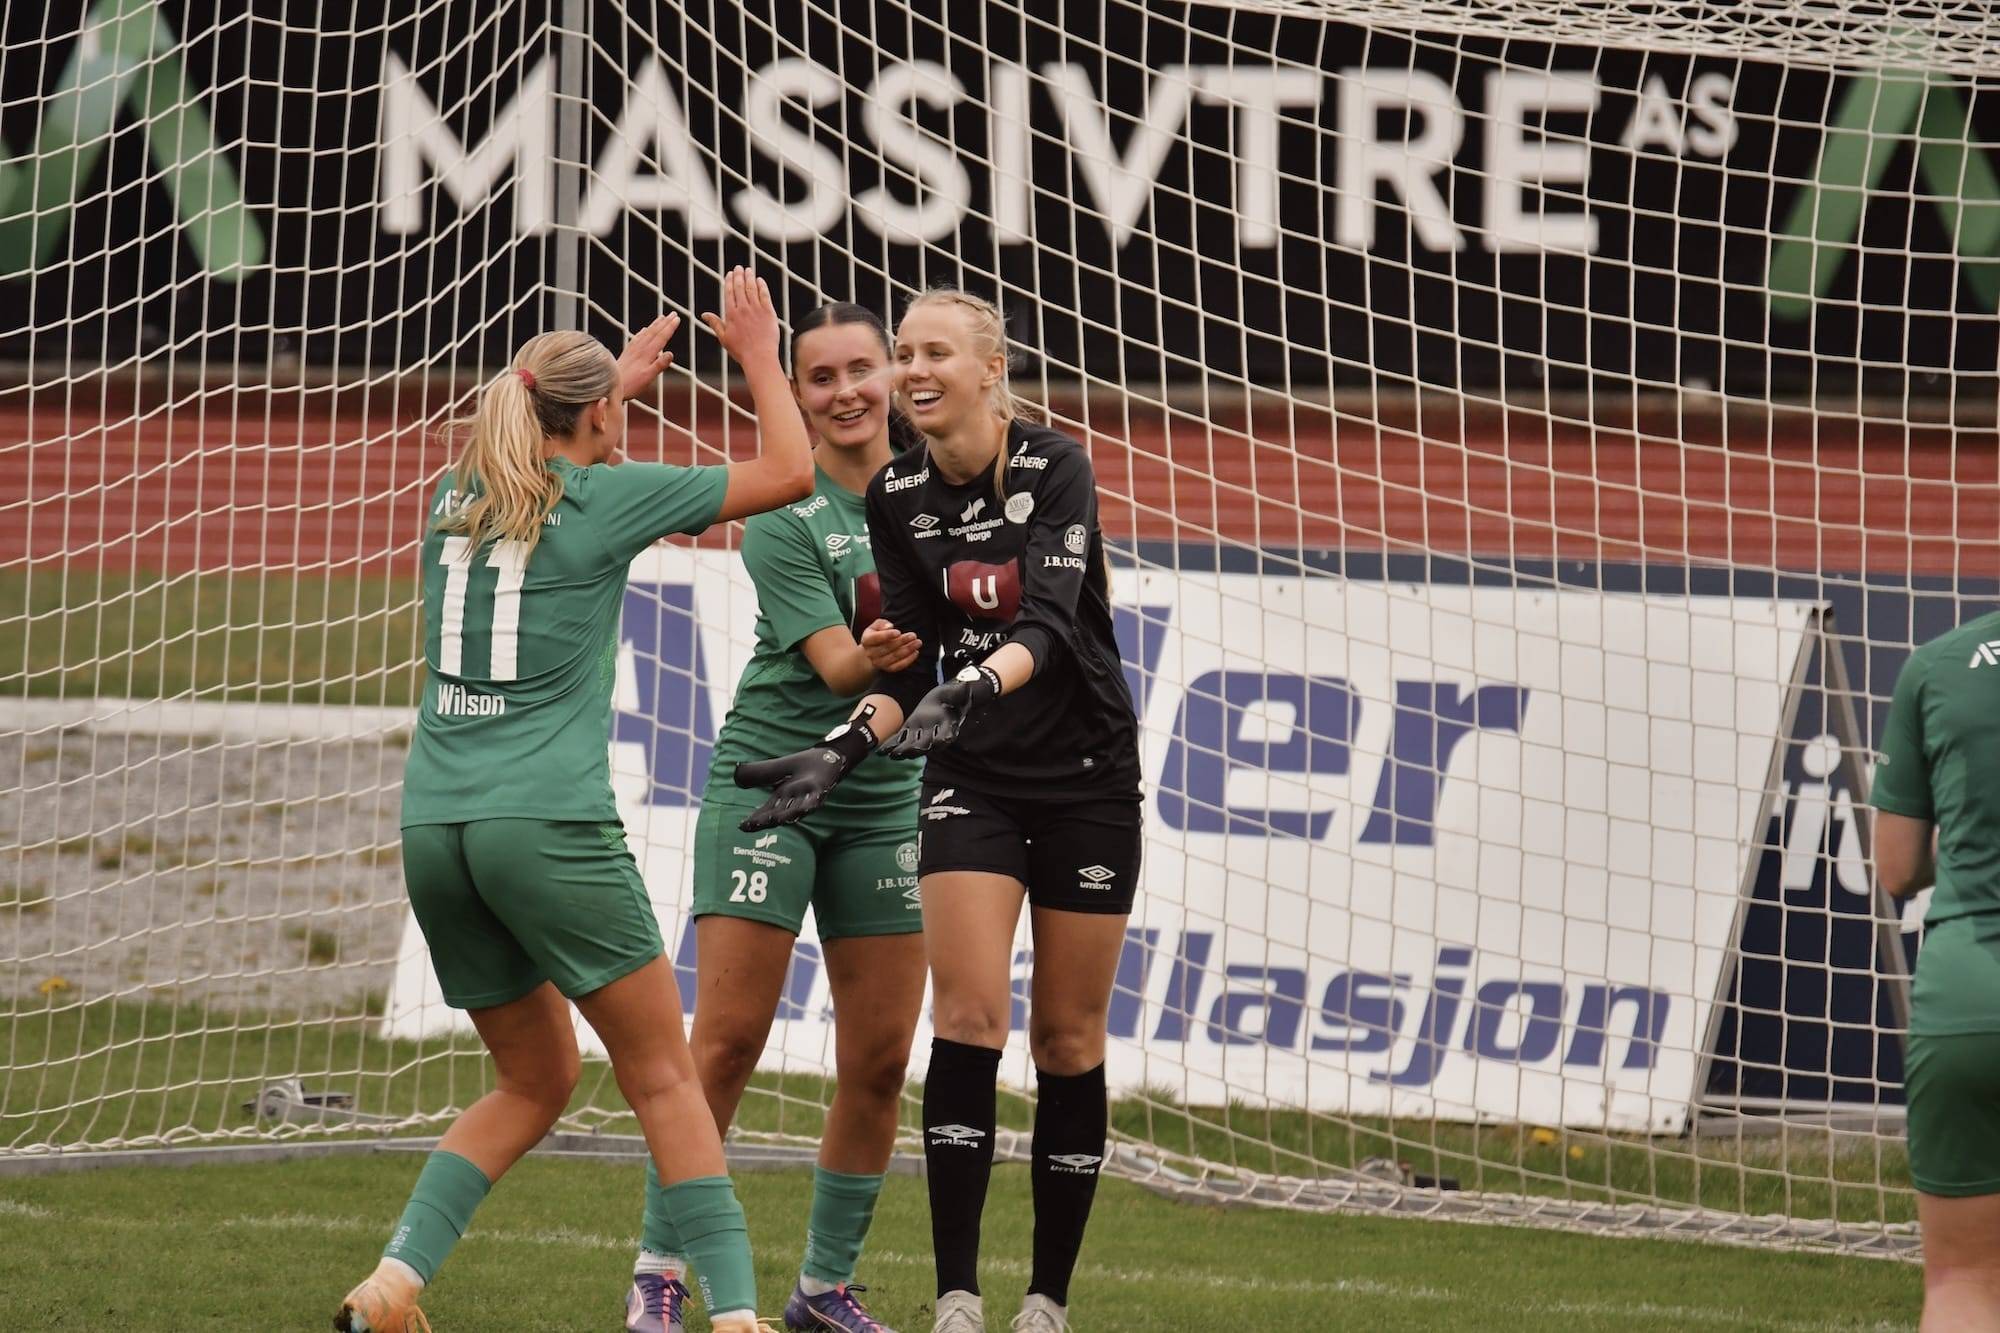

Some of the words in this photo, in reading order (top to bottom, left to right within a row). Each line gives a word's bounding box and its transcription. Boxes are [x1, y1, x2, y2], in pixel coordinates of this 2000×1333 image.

[381, 49, 1601, 254] MASSIVTRE
[1620, 73, 1739, 159] AS
[1010, 456, 1049, 470] ENERG
[914, 529, 941, 539] umbro
[948, 518, 1004, 537] Sparebanken
[966, 530, 992, 542] Norge
[438, 536, 539, 680] 11
[437, 684, 506, 716] Wilson
[752, 856, 776, 868] Norge
[729, 869, 769, 904] 28
[1079, 881, 1112, 891] umbro
